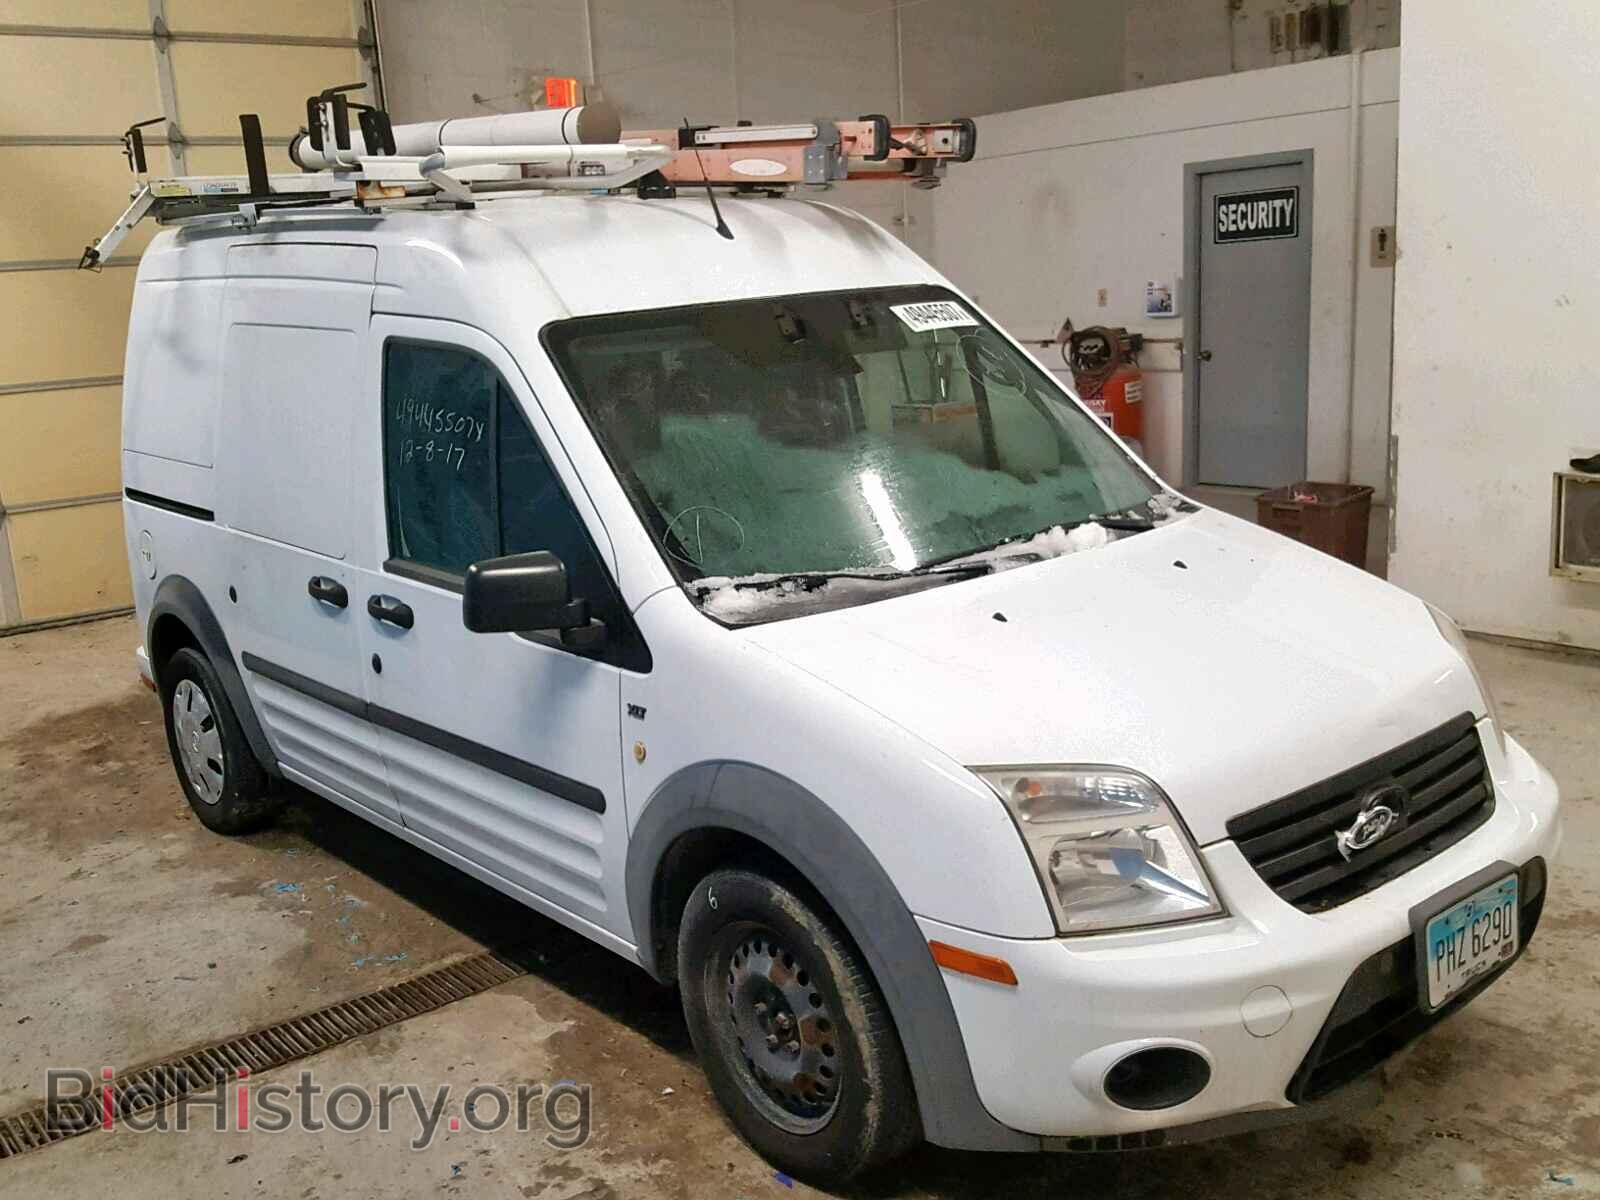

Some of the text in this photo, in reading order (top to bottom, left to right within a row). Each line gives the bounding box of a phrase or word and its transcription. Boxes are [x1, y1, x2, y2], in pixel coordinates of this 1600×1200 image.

[1218, 198, 1294, 233] SECURITY
[1435, 900, 1513, 983] PHZ 6290
